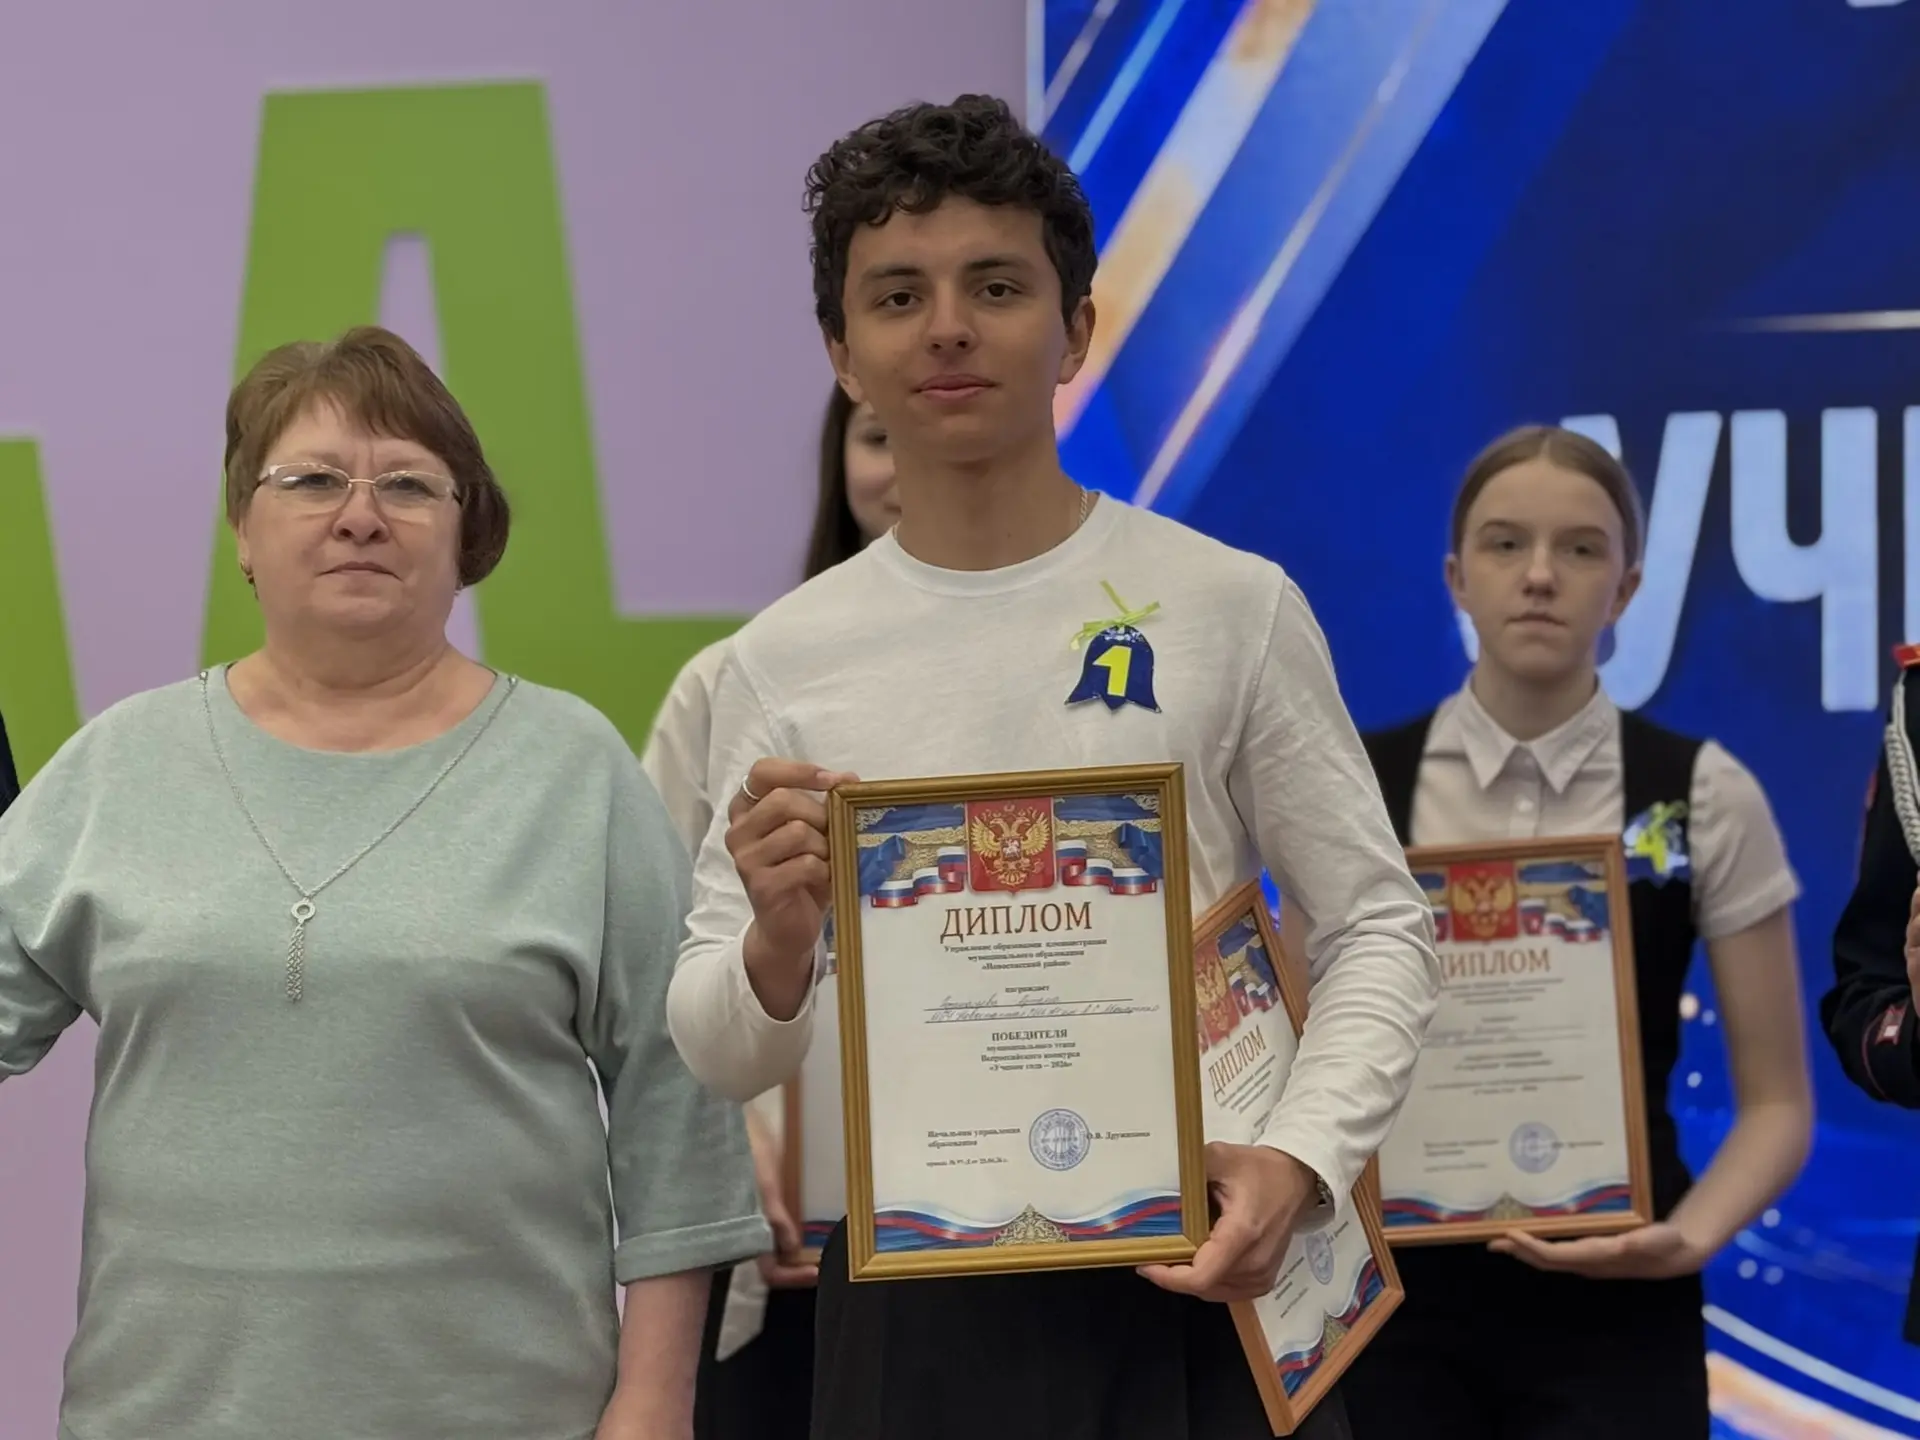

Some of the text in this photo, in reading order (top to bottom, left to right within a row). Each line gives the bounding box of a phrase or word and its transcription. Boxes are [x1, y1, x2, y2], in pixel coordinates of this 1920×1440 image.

[1456, 404, 1920, 712] УЧ
[1092, 645, 1132, 697] 1
[940, 901, 1093, 944] ДИПЛОМ
[991, 1028, 1067, 1041] ПОБЕДИТЕЛЯ
[1208, 1023, 1267, 1099] ДИПЛОМ
